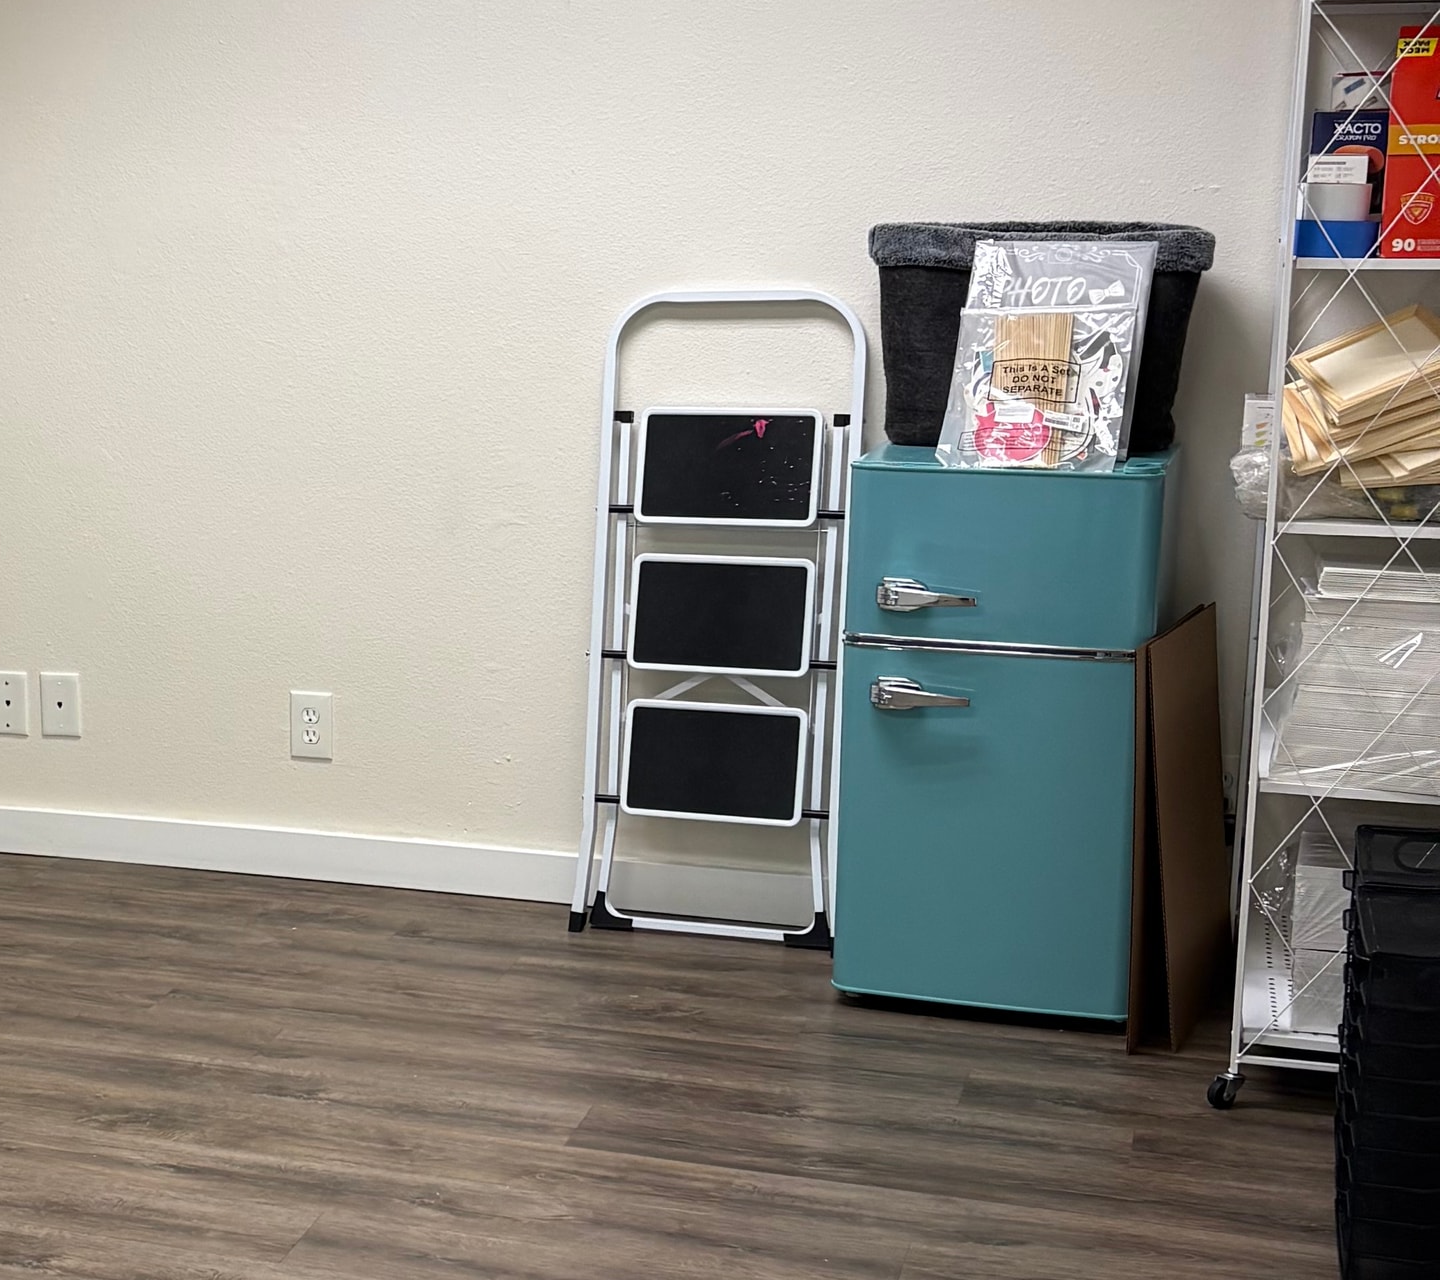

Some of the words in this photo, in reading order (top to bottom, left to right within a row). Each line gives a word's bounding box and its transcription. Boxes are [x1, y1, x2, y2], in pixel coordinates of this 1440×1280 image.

[1398, 134, 1440, 145] STRO
[1391, 238, 1416, 252] 90
[1003, 365, 1025, 374] This
[1041, 364, 1049, 372] A
[1012, 375, 1029, 383] DO
[1032, 374, 1057, 384] NOT
[1002, 384, 1063, 396] SEPARATE
